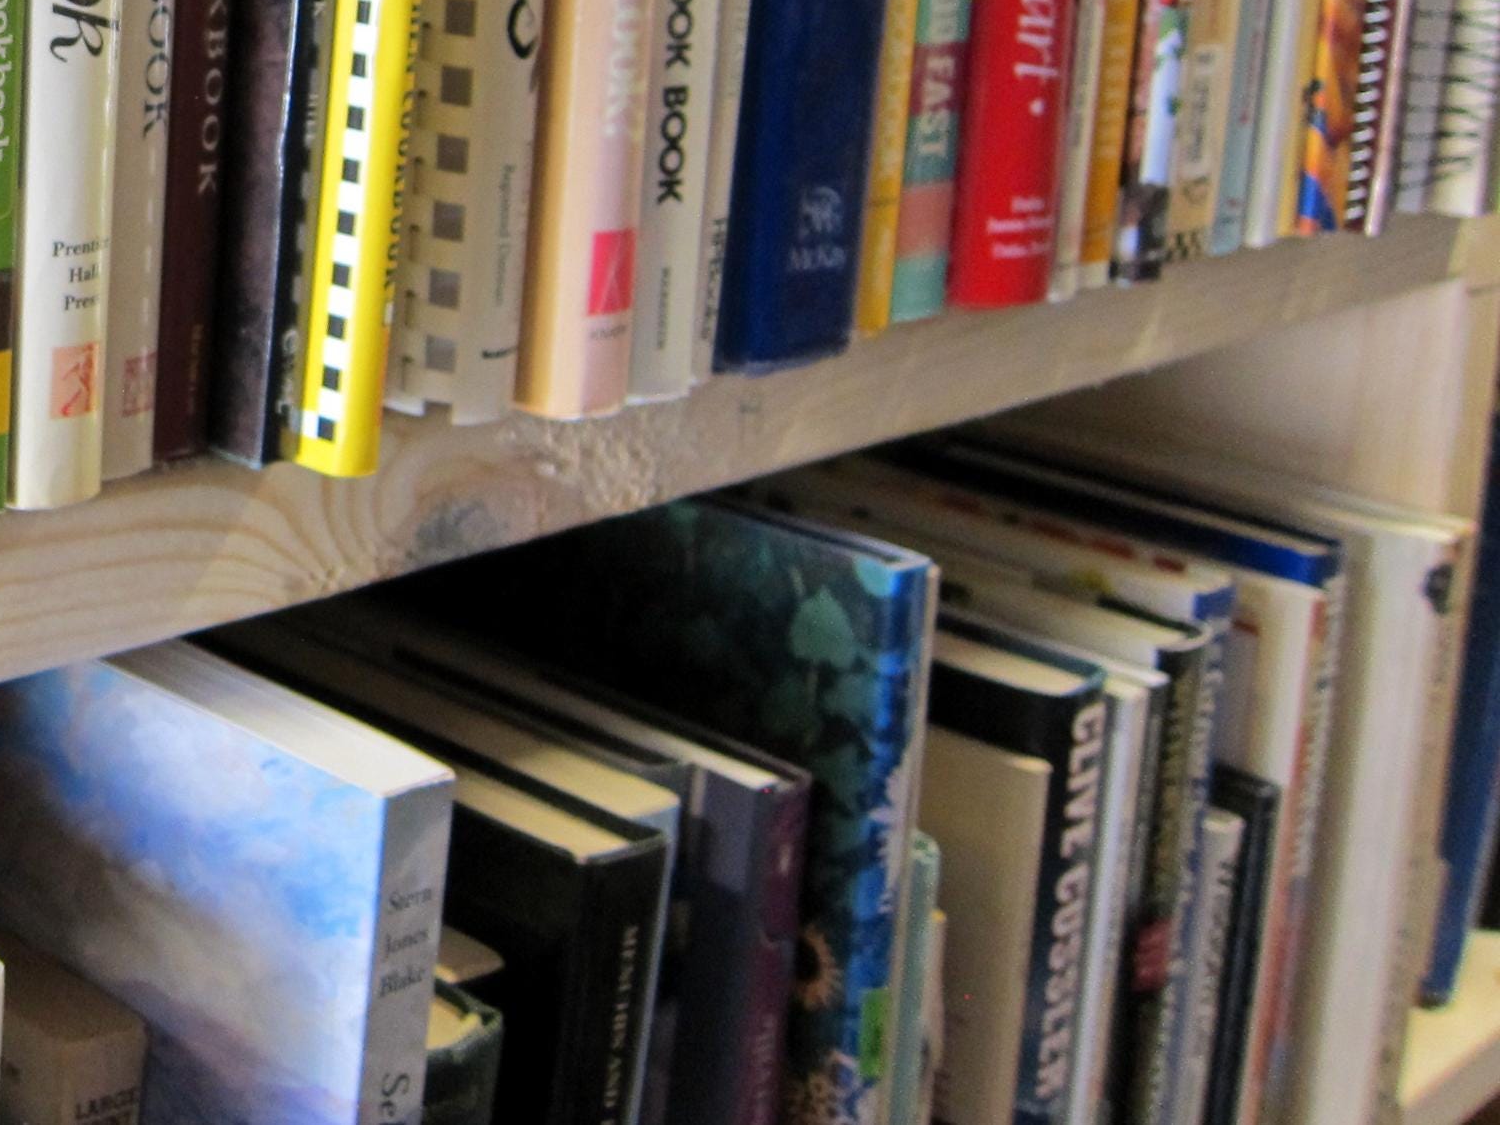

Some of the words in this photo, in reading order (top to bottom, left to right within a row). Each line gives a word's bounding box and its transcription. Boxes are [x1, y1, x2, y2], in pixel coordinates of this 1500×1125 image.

[656, 85, 689, 205] BOOK
[914, 55, 958, 161] FAST
[1060, 702, 1107, 860] CLIVE
[1035, 873, 1098, 1101] CUSSLER
